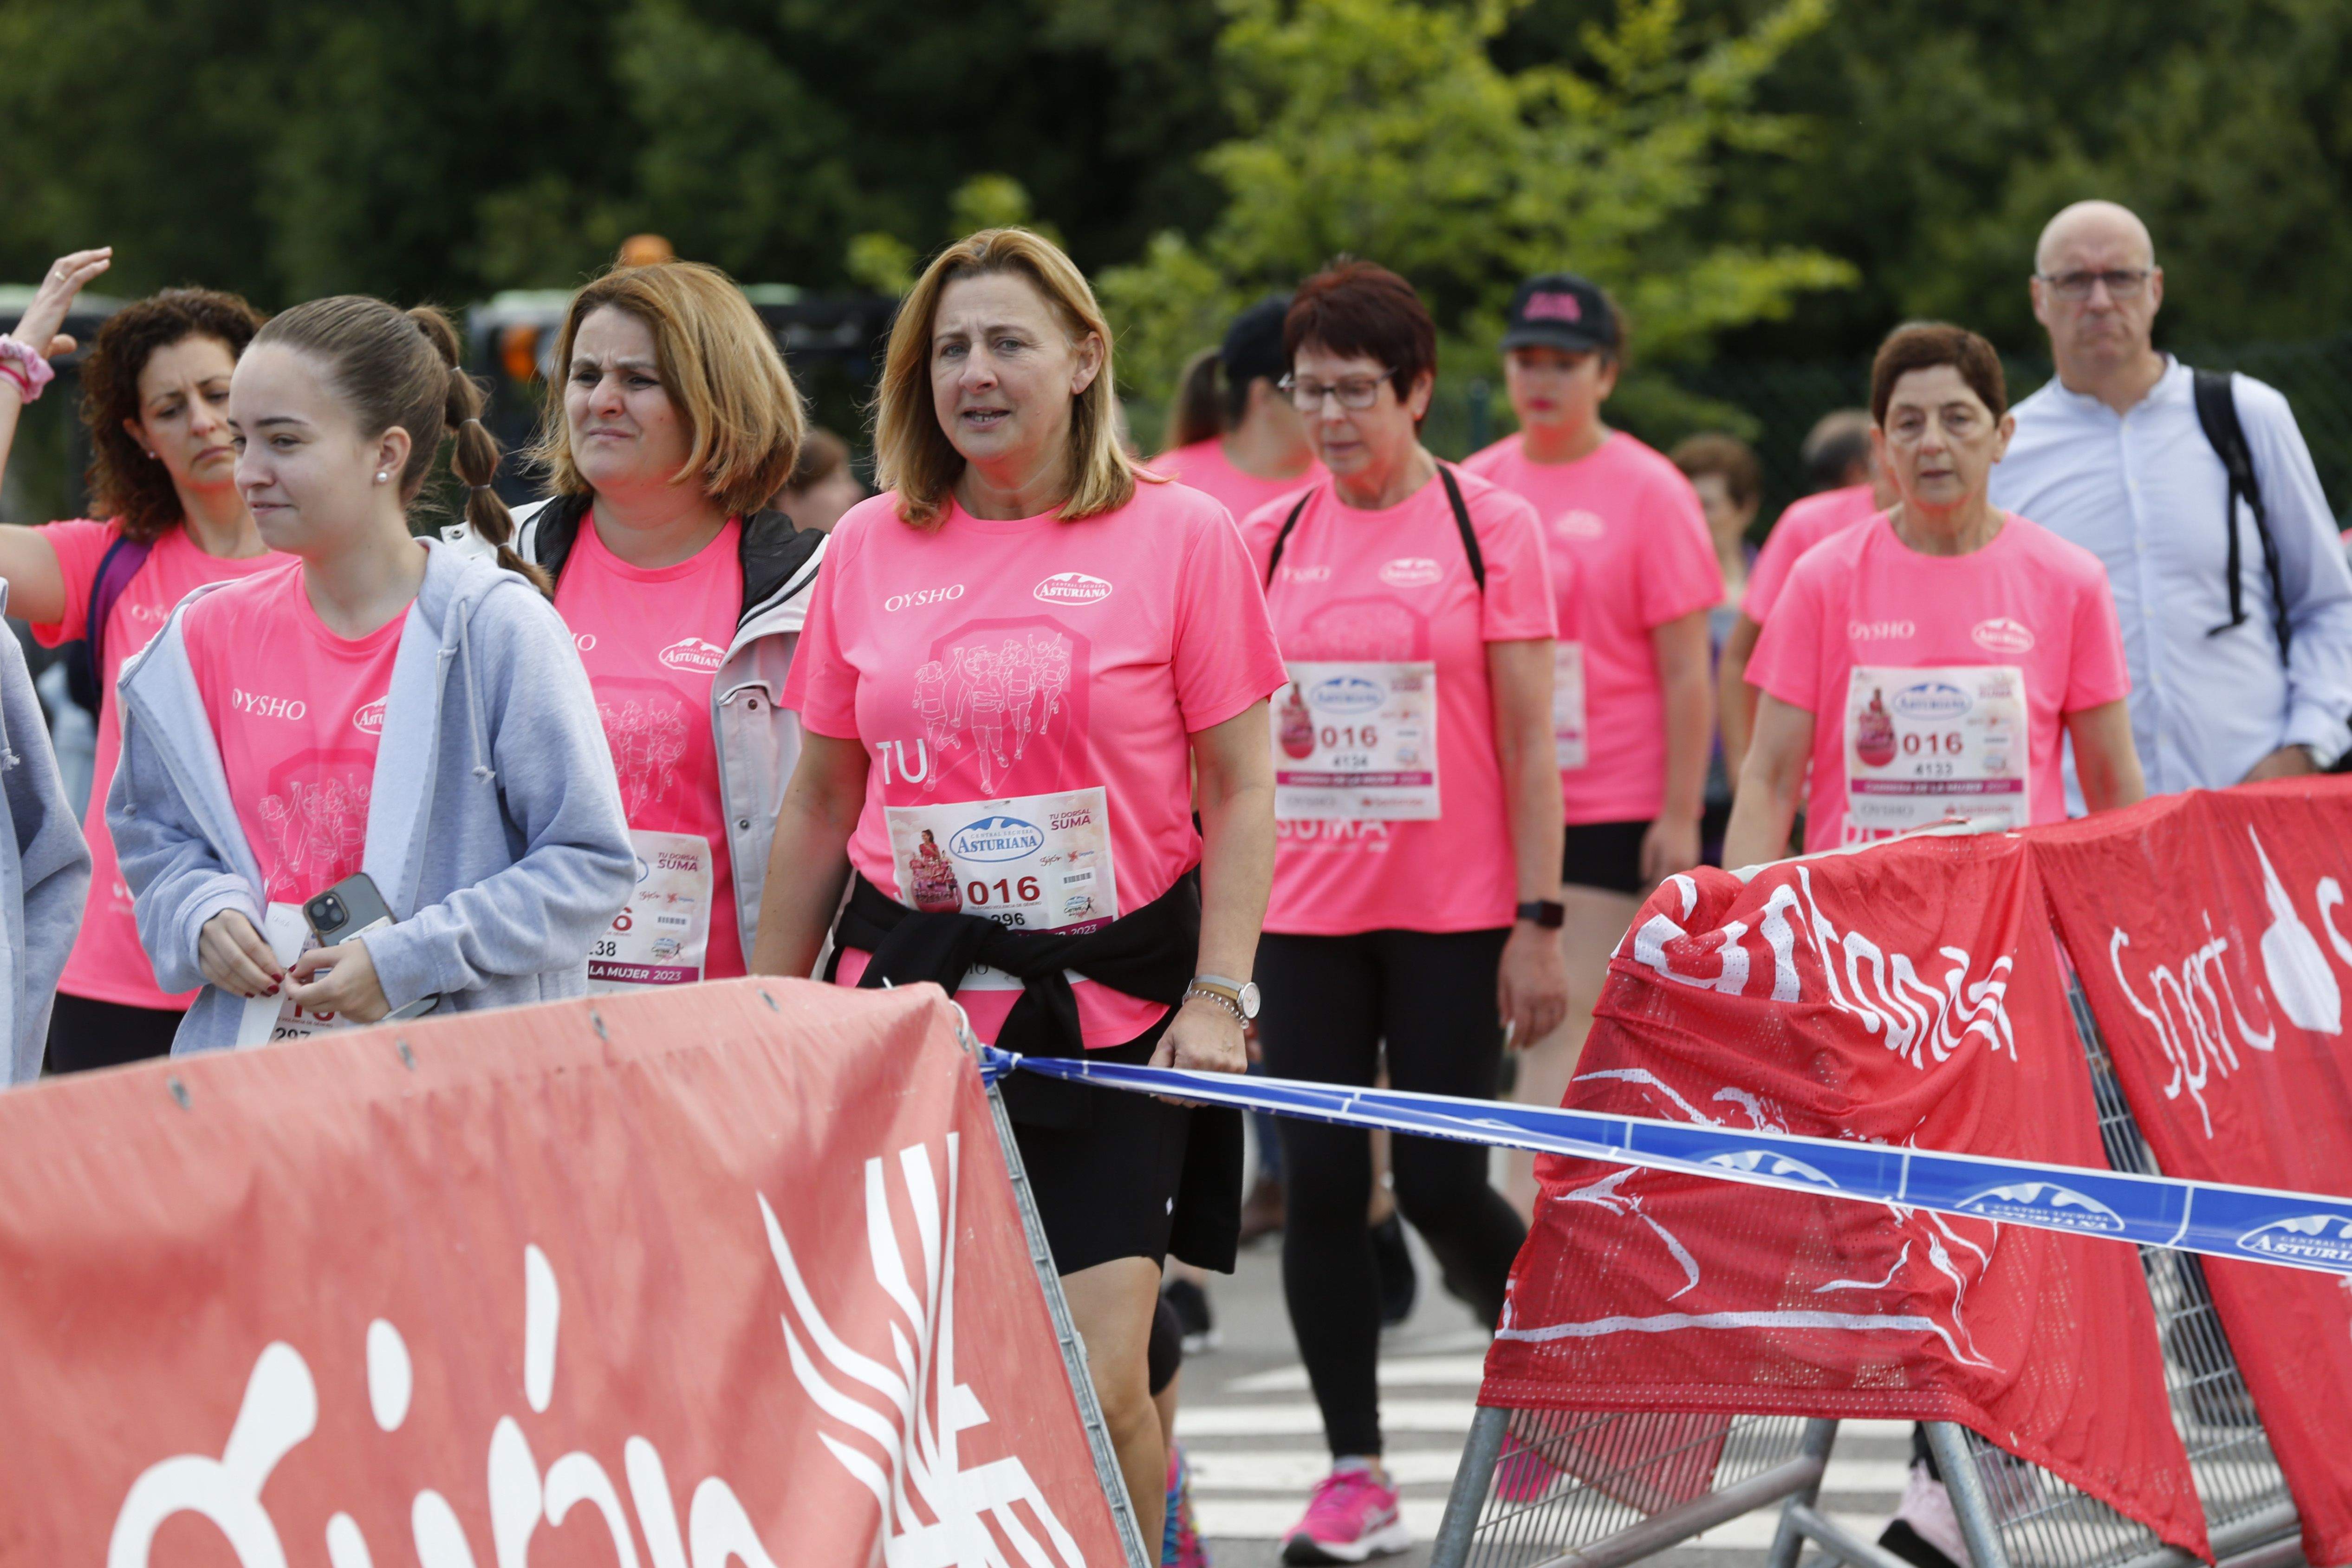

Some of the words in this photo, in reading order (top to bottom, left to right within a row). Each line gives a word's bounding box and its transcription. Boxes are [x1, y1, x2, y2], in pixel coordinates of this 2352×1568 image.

[884, 584, 965, 612] OYSHO
[1039, 584, 1105, 598] ASTURIANA
[1847, 619, 1915, 640] OYSHO
[664, 650, 720, 668] ASTURIAN
[233, 688, 306, 720] OYSHO
[1321, 725, 1377, 748] 016
[1904, 732, 1963, 755] 016
[876, 738, 928, 785] TU
[1051, 815, 1091, 830] SUMA
[1061, 808, 1091, 819] DORSAL
[957, 836, 1038, 853] ASTURIANA
[657, 859, 698, 872] SUMA
[968, 876, 1040, 905] 016
[589, 941, 616, 956] 38
[589, 965, 604, 976] LA
[607, 968, 650, 979] MUJER
[653, 970, 682, 981] 2023
